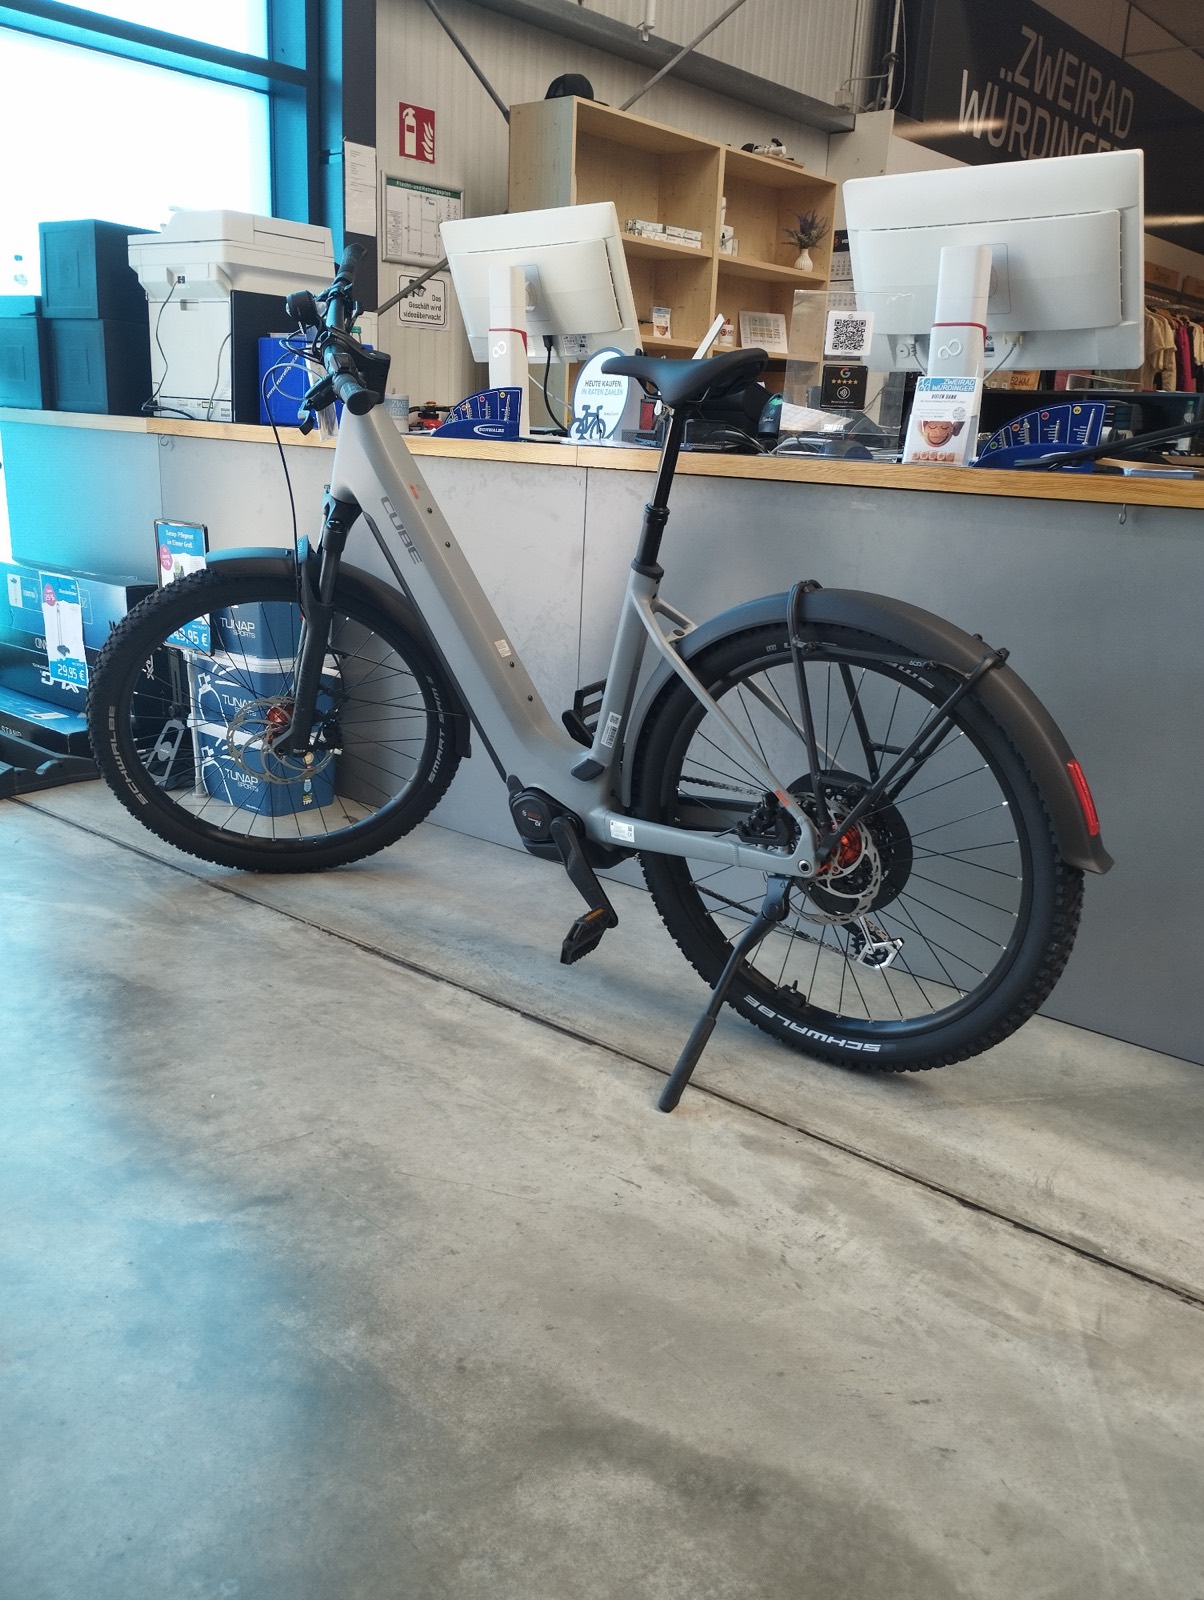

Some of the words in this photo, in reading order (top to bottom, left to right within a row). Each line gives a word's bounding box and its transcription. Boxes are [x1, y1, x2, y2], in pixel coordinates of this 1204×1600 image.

[1014, 25, 1134, 139] ZWEIRAD
[958, 67, 1121, 159] WÜRDIN
[408, 301, 430, 310] Geschäft
[430, 303, 441, 311] wird
[432, 294, 441, 302] Das
[403, 311, 441, 321] videoüberwacht
[380, 496, 423, 564] CUBE
[220, 617, 255, 631] TUNAP
[170, 627, 199, 644] 49,95
[233, 630, 256, 638] SPORTS
[57, 663, 78, 680] 29,95
[79, 669, 85, 682] €
[108, 705, 149, 805] SCHWALBE
[225, 767, 259, 784] TUNAP
[237, 781, 259, 792] SPORTS
[743, 994, 881, 1052] SCHWALBE
